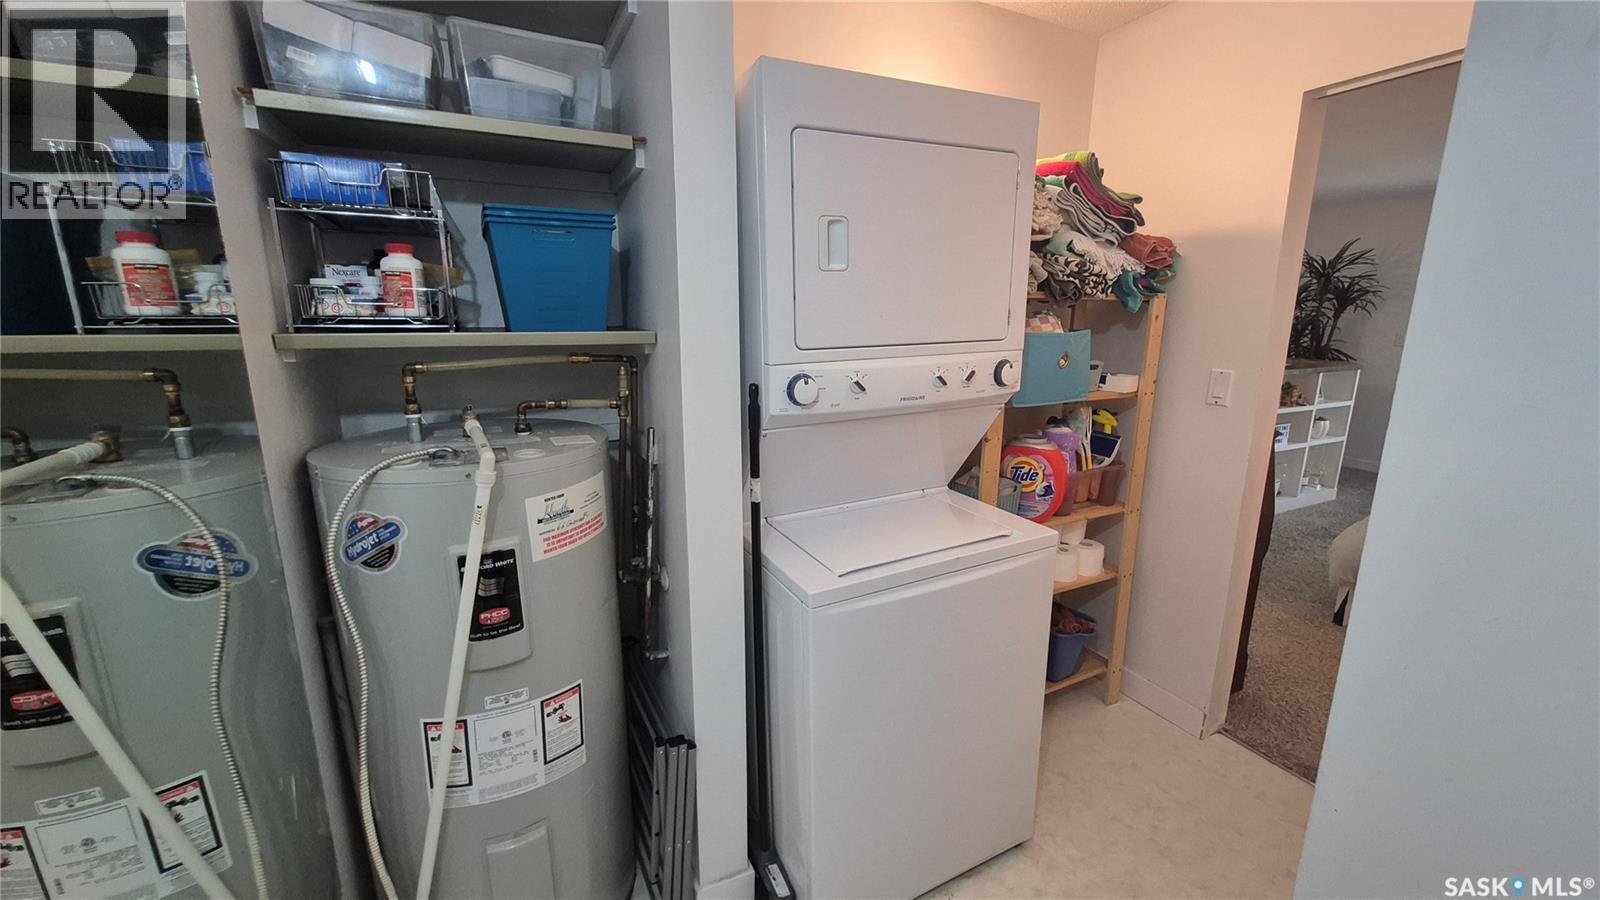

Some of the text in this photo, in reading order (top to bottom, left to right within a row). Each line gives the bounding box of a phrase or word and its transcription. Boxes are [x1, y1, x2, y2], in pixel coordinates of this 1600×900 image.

[331, 267, 361, 277] Nexcare
[1010, 465, 1039, 482] Tide
[346, 533, 379, 558] Hydrojet
